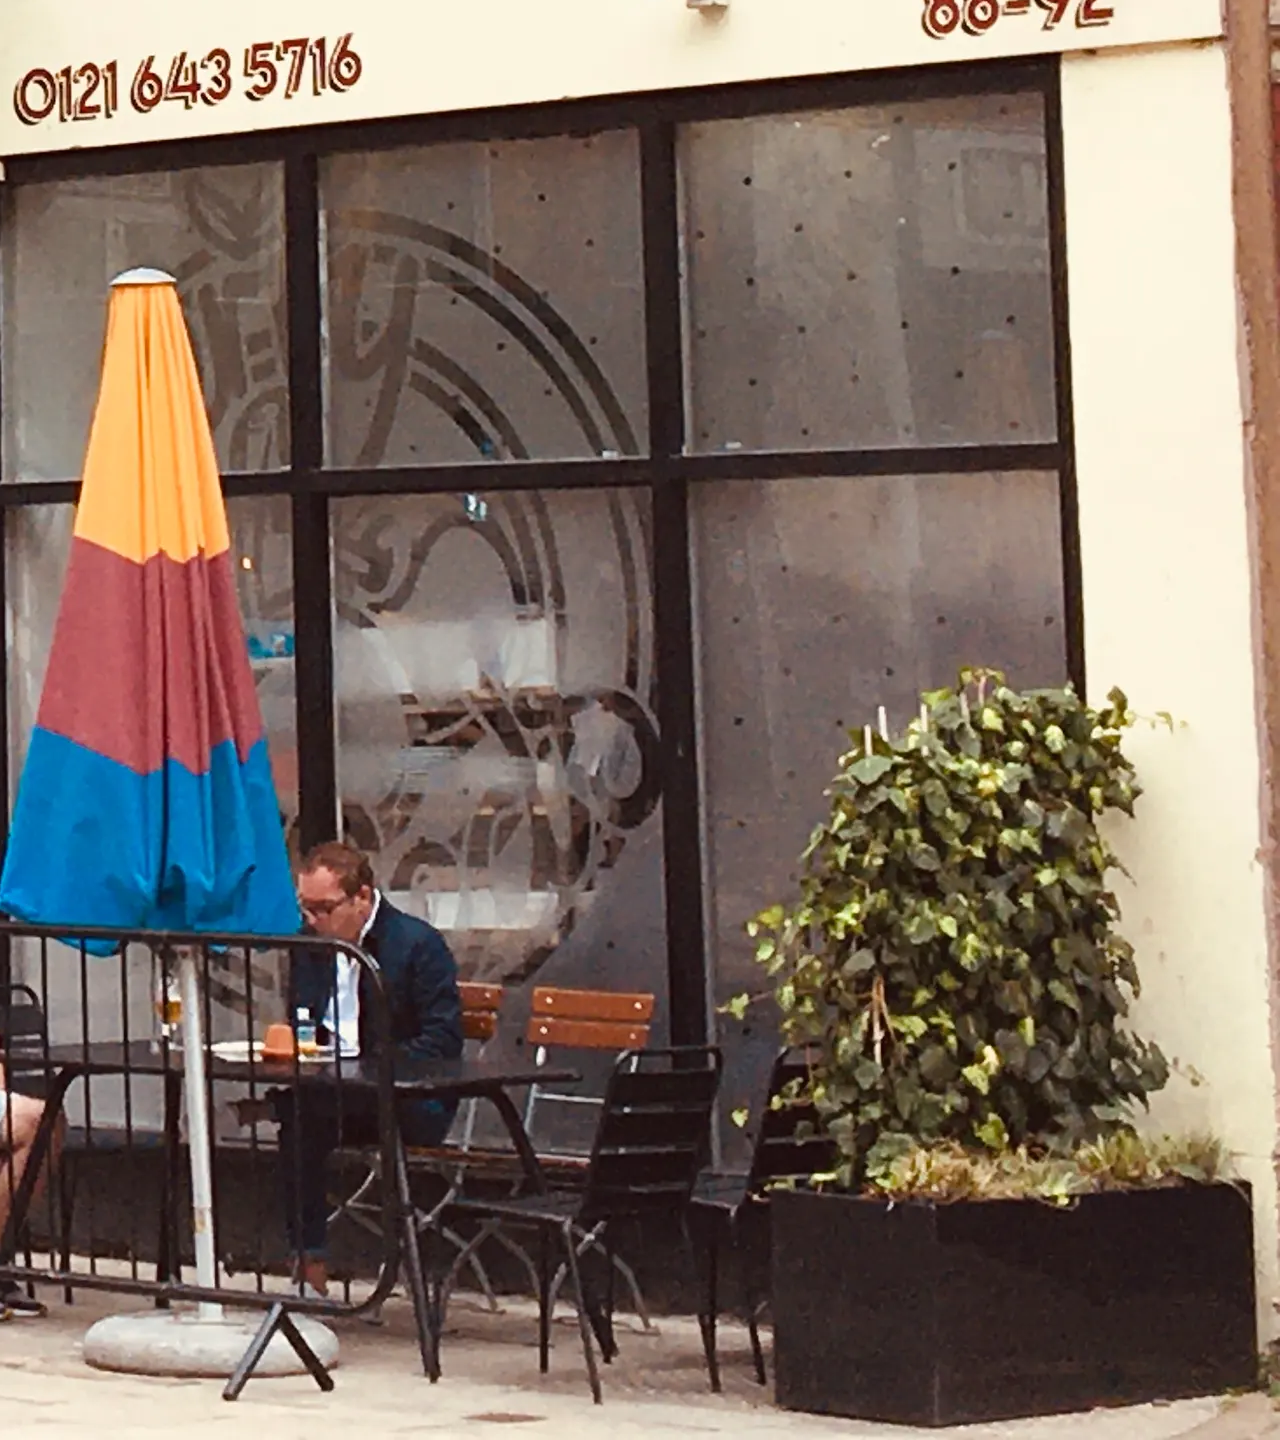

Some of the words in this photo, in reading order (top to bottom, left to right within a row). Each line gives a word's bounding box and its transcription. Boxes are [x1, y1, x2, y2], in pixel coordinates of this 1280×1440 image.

[13, 61, 118, 126] 0121
[130, 48, 232, 114] 643
[242, 32, 363, 102] 5716
